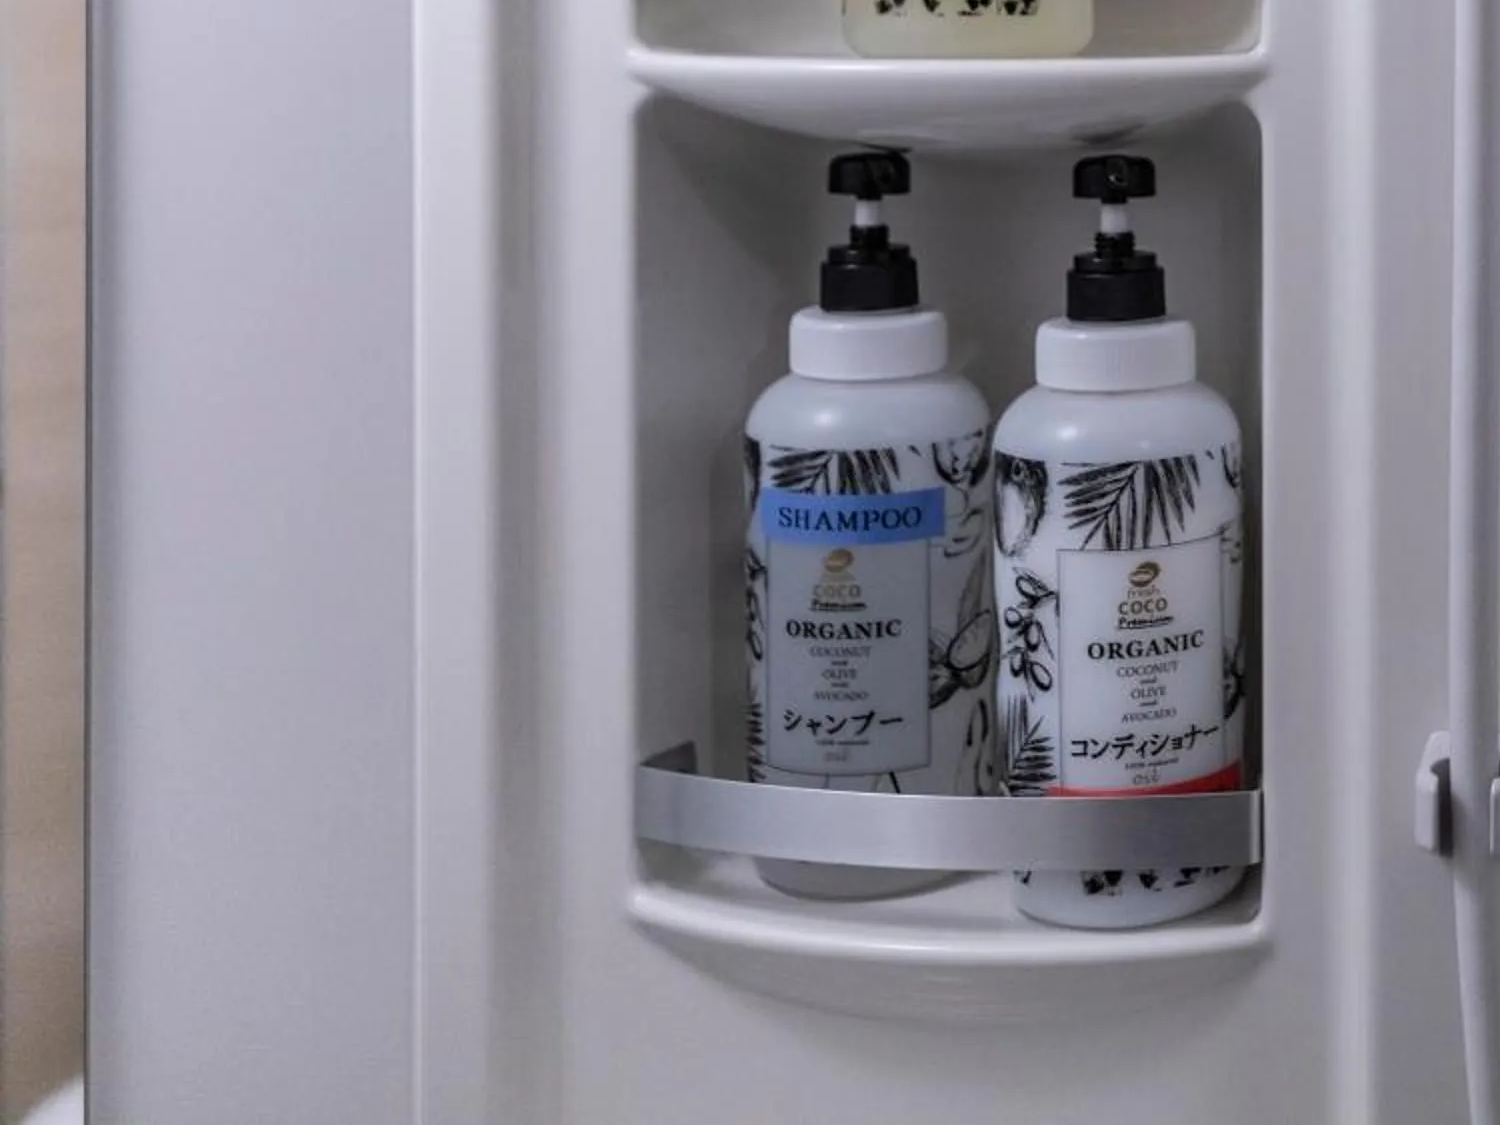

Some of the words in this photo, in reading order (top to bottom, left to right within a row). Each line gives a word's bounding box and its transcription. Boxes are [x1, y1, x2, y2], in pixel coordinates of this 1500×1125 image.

[778, 506, 922, 532] SHAMPOO
[1118, 597, 1168, 615] COCO
[786, 619, 902, 640] ORGANIC
[1087, 630, 1205, 660] ORGANIC
[1117, 660, 1179, 677] COCONUT
[1130, 685, 1167, 700] OLIVE
[783, 709, 904, 736] シャンプー
[1121, 707, 1178, 724] AVOCADO
[1071, 724, 1219, 760] コンディショナー
